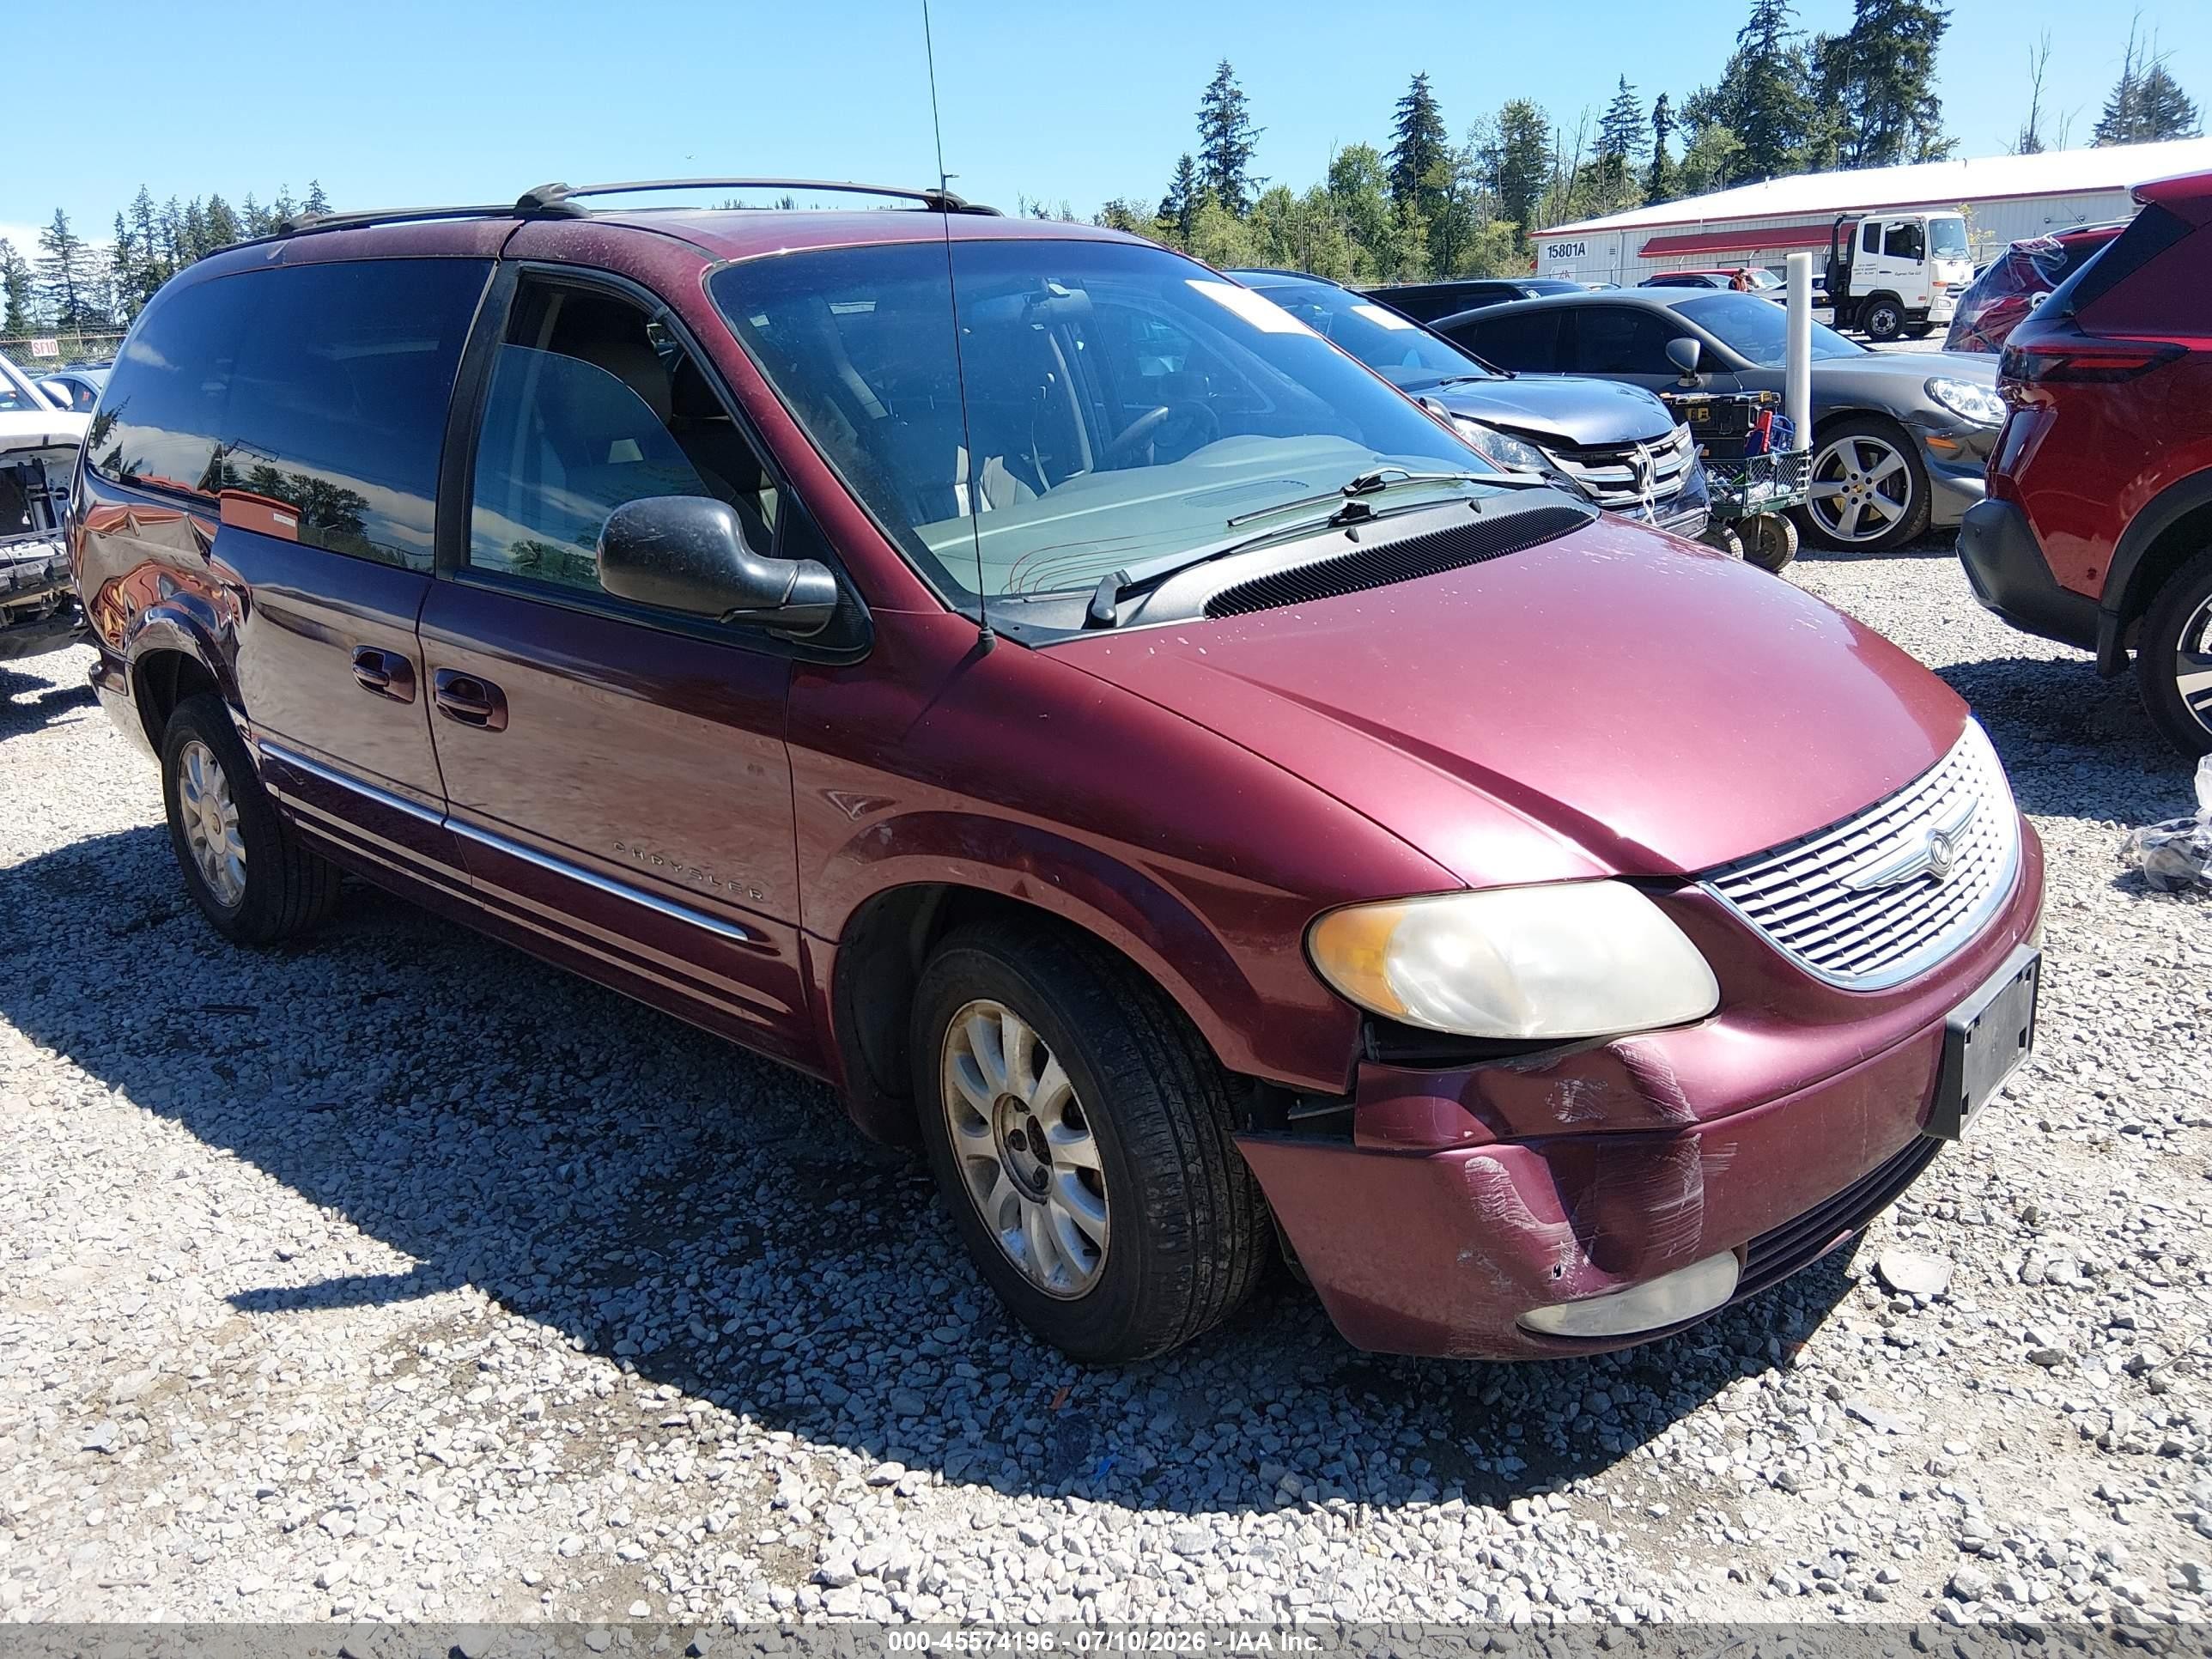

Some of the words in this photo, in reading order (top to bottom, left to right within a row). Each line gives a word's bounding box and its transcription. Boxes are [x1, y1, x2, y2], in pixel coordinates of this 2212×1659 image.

[1547, 242, 1585, 258] 15801A
[33, 342, 58, 355] SF10
[613, 841, 763, 901] CHRYSLER
